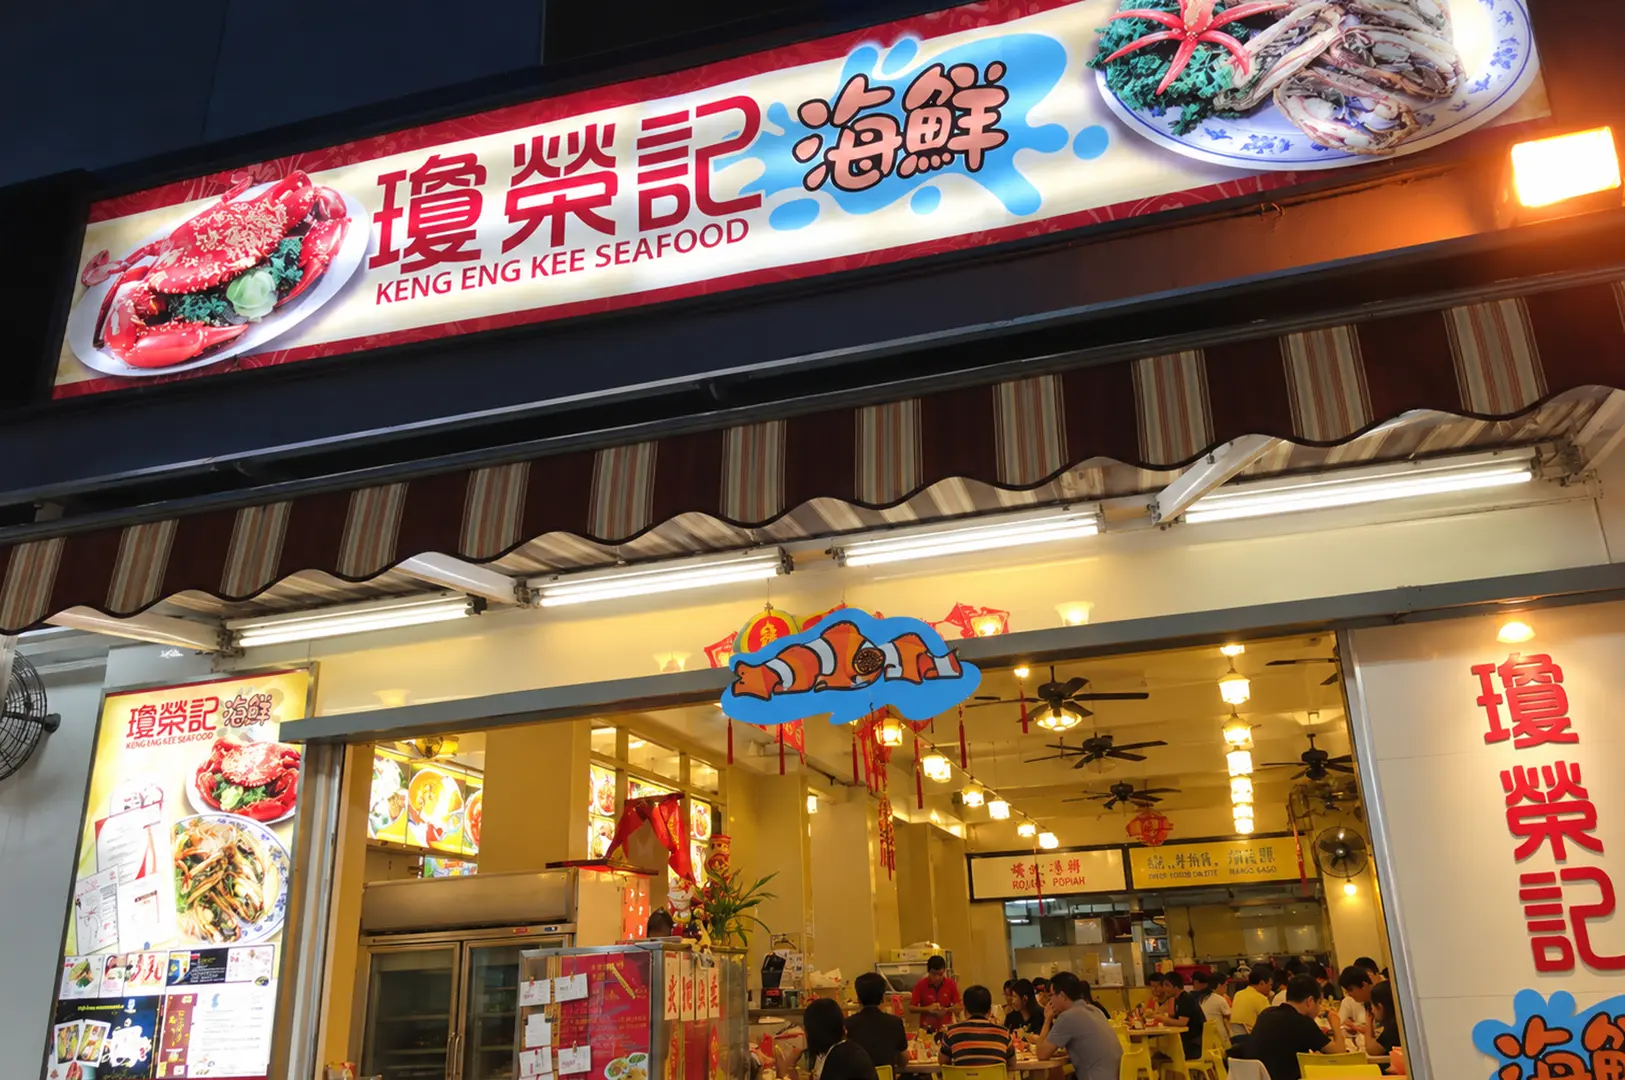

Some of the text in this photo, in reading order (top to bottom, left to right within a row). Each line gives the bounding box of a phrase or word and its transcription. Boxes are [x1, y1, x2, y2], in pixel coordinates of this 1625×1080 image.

[368, 60, 1010, 274] 瓊榮記 海鮮
[375, 217, 750, 305] KENG ENG KEE SEAFOOD
[1053, 876, 1086, 887] POPIAH
